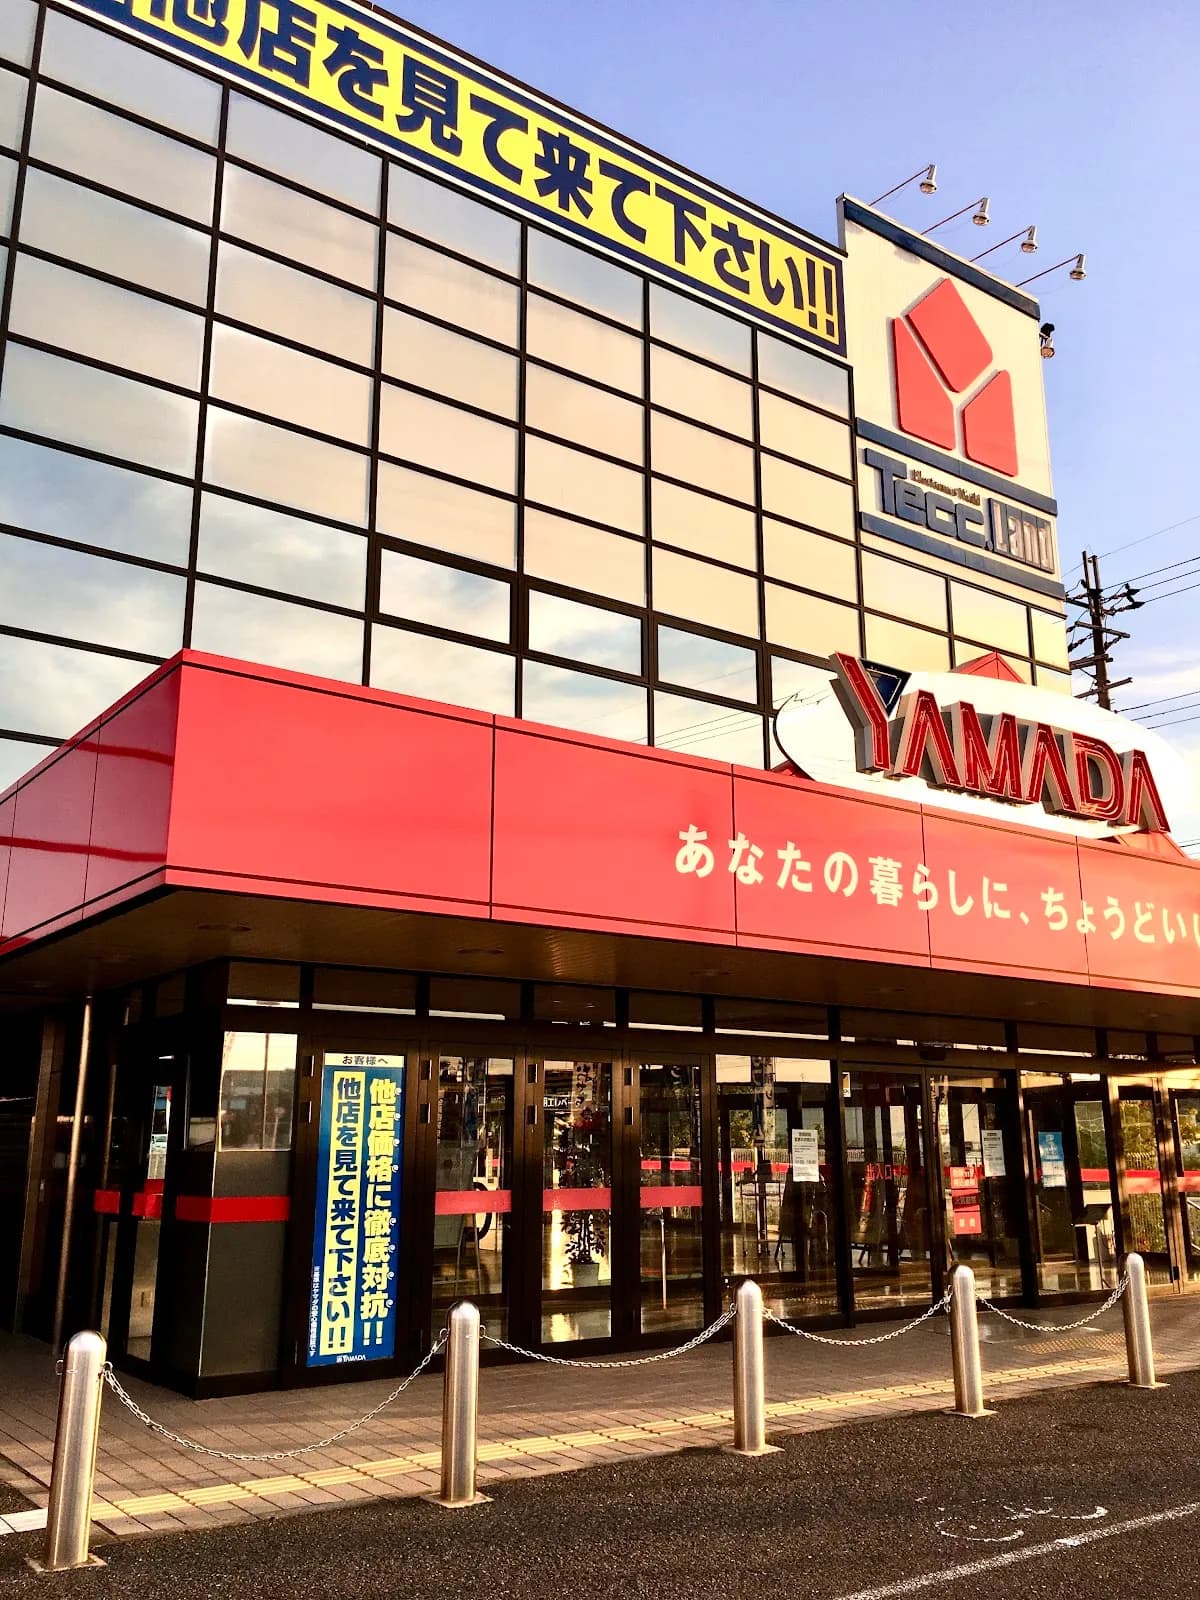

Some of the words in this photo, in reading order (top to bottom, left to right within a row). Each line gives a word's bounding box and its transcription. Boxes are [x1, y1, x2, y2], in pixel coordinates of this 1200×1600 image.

[829, 651, 1171, 833] YAMADA
[342, 1055, 389, 1066] お客様へ
[326, 1077, 361, 1349] 他店を見て来て下さい!!
